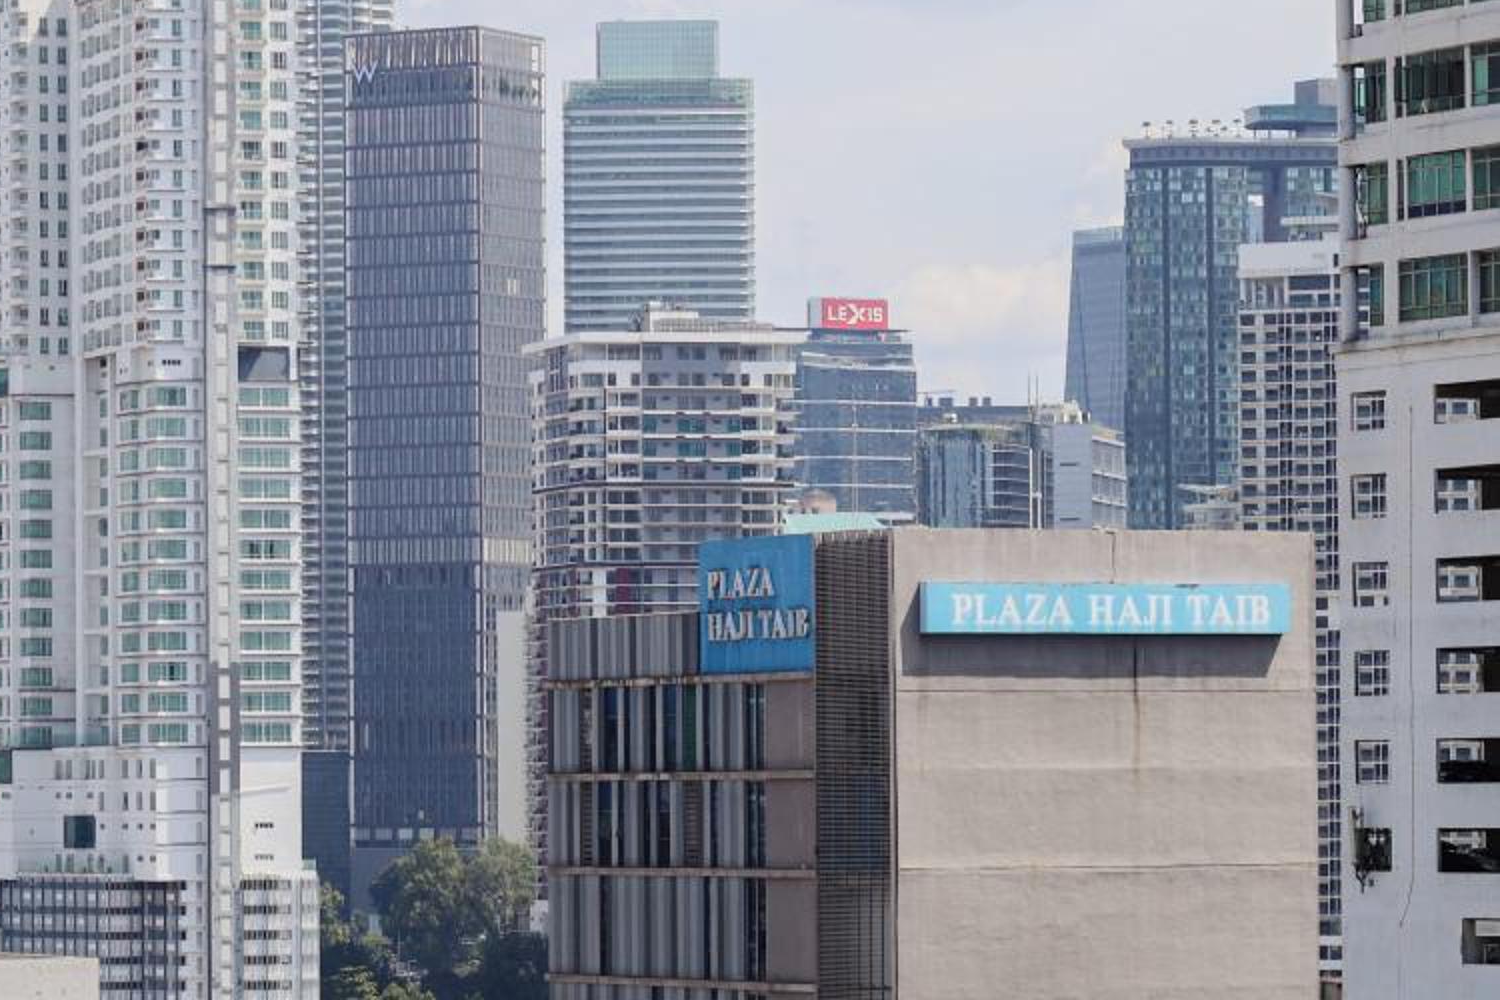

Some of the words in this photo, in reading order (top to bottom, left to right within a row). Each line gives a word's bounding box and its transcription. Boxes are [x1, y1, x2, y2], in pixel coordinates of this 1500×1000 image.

[353, 60, 379, 83] W
[827, 303, 883, 325] LEXIS
[707, 568, 775, 600] PLAZA
[707, 611, 754, 641] HAJI
[758, 607, 809, 639] TAIB
[952, 593, 1074, 626] PLAZA
[1089, 593, 1173, 626] HAJI
[1187, 593, 1272, 627] TAIB
